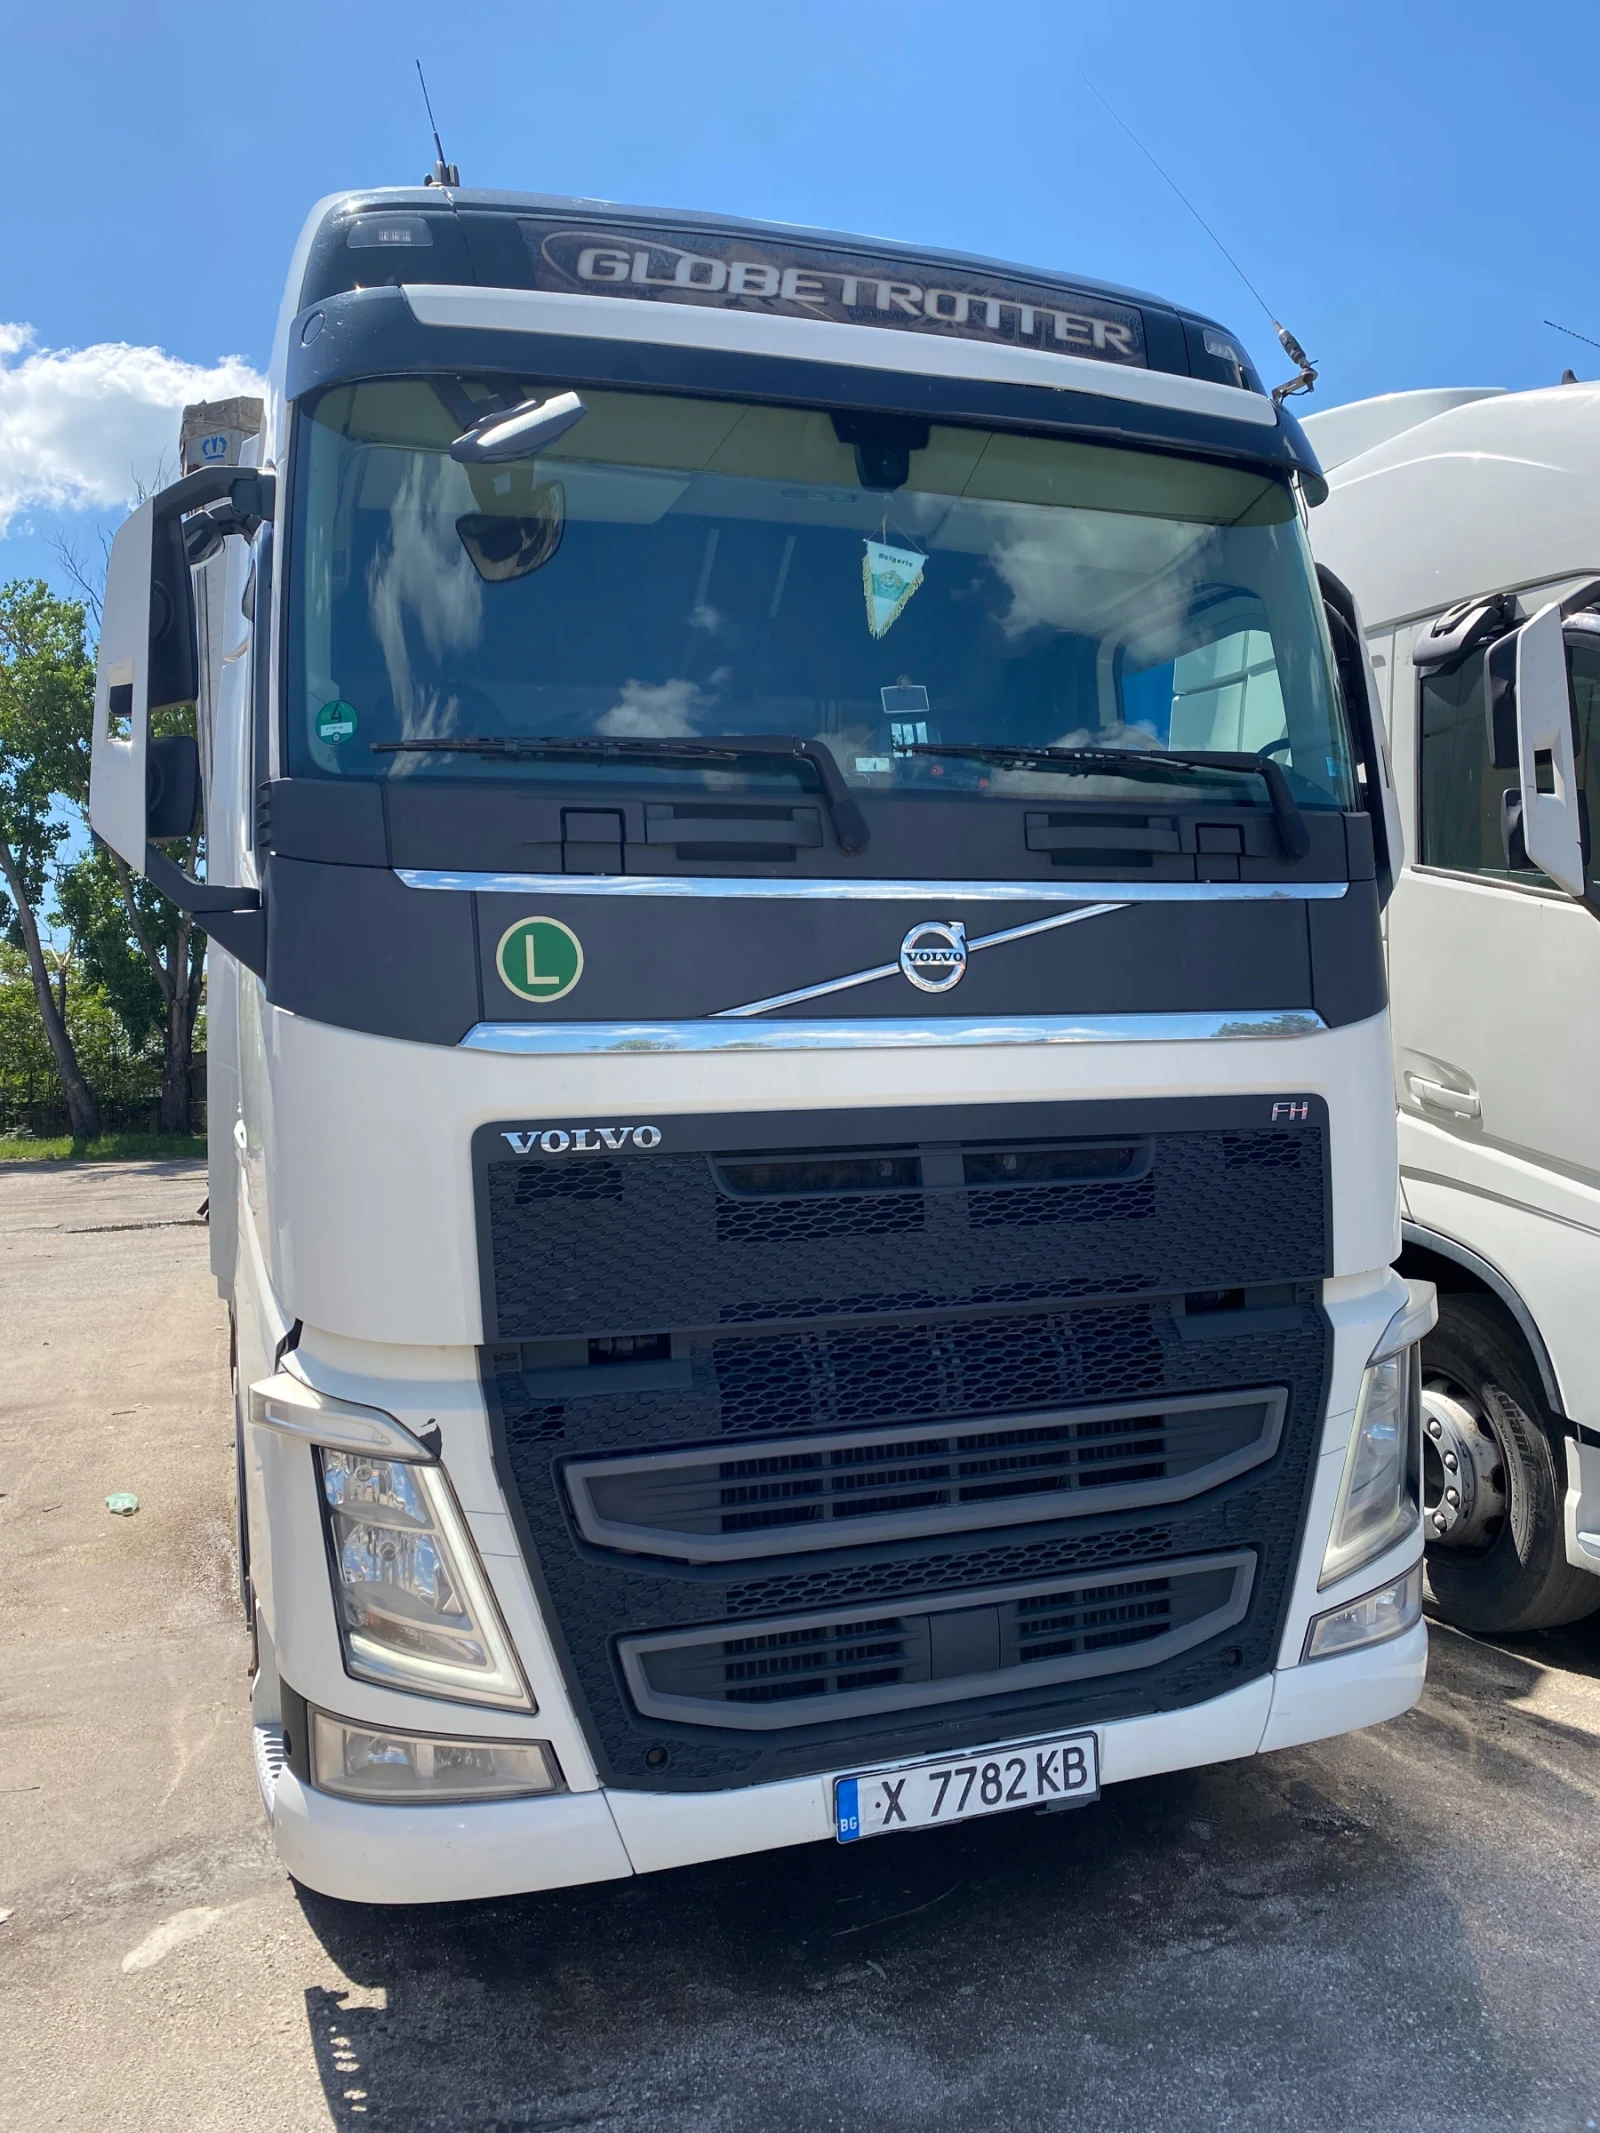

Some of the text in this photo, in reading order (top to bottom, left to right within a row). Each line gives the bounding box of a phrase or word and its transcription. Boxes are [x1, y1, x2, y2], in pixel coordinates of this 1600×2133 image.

[576, 247, 1133, 355] GLOBETROTTER
[330, 702, 344, 723] 4
[524, 934, 560, 985] L
[904, 952, 964, 962] VOLVO
[1271, 1101, 1309, 1121] FH
[500, 1125, 662, 1154] VOLVO
[840, 1816, 858, 1831] BG
